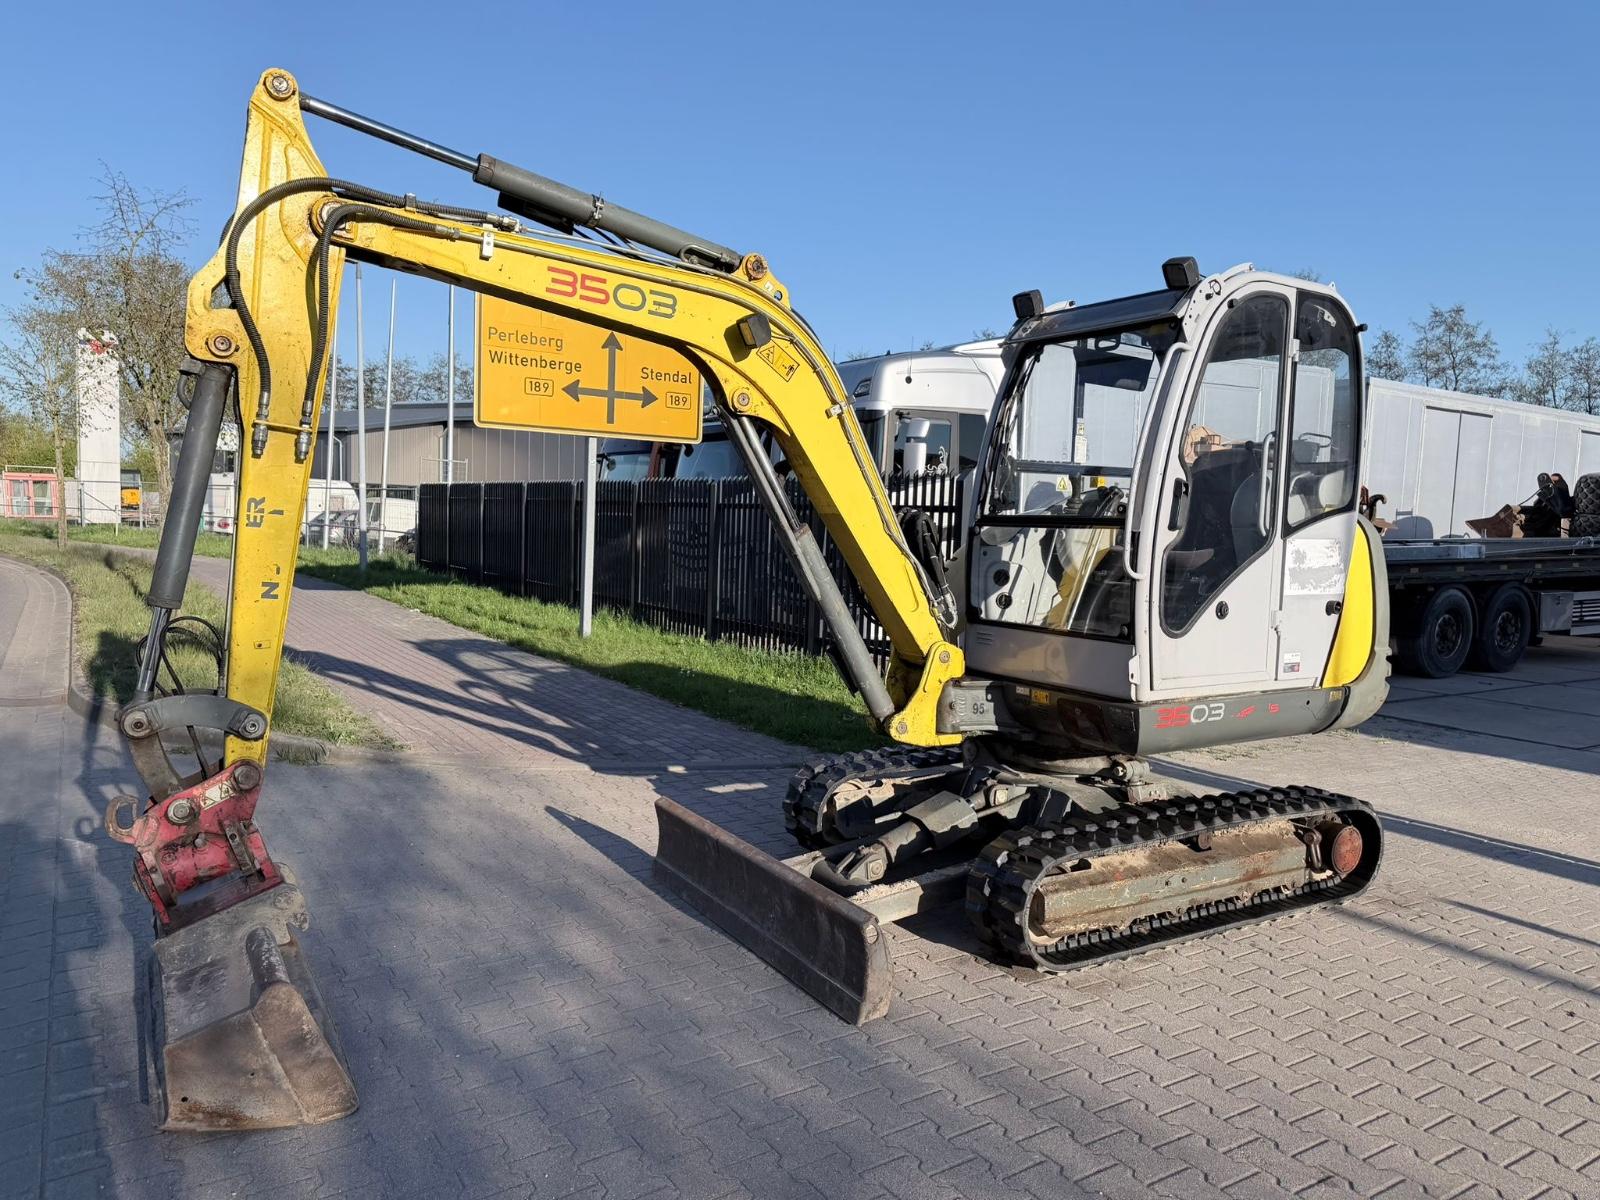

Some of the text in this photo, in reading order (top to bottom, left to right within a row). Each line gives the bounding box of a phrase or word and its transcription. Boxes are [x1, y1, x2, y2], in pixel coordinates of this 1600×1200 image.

[546, 266, 677, 318] 3503
[488, 326, 564, 351] Perleberg
[489, 350, 582, 374] Wittenberge
[641, 367, 692, 384] Stendal
[528, 380, 550, 393] 189
[670, 394, 688, 407] 189
[972, 702, 985, 715] 95
[1153, 703, 1225, 729] 3503
